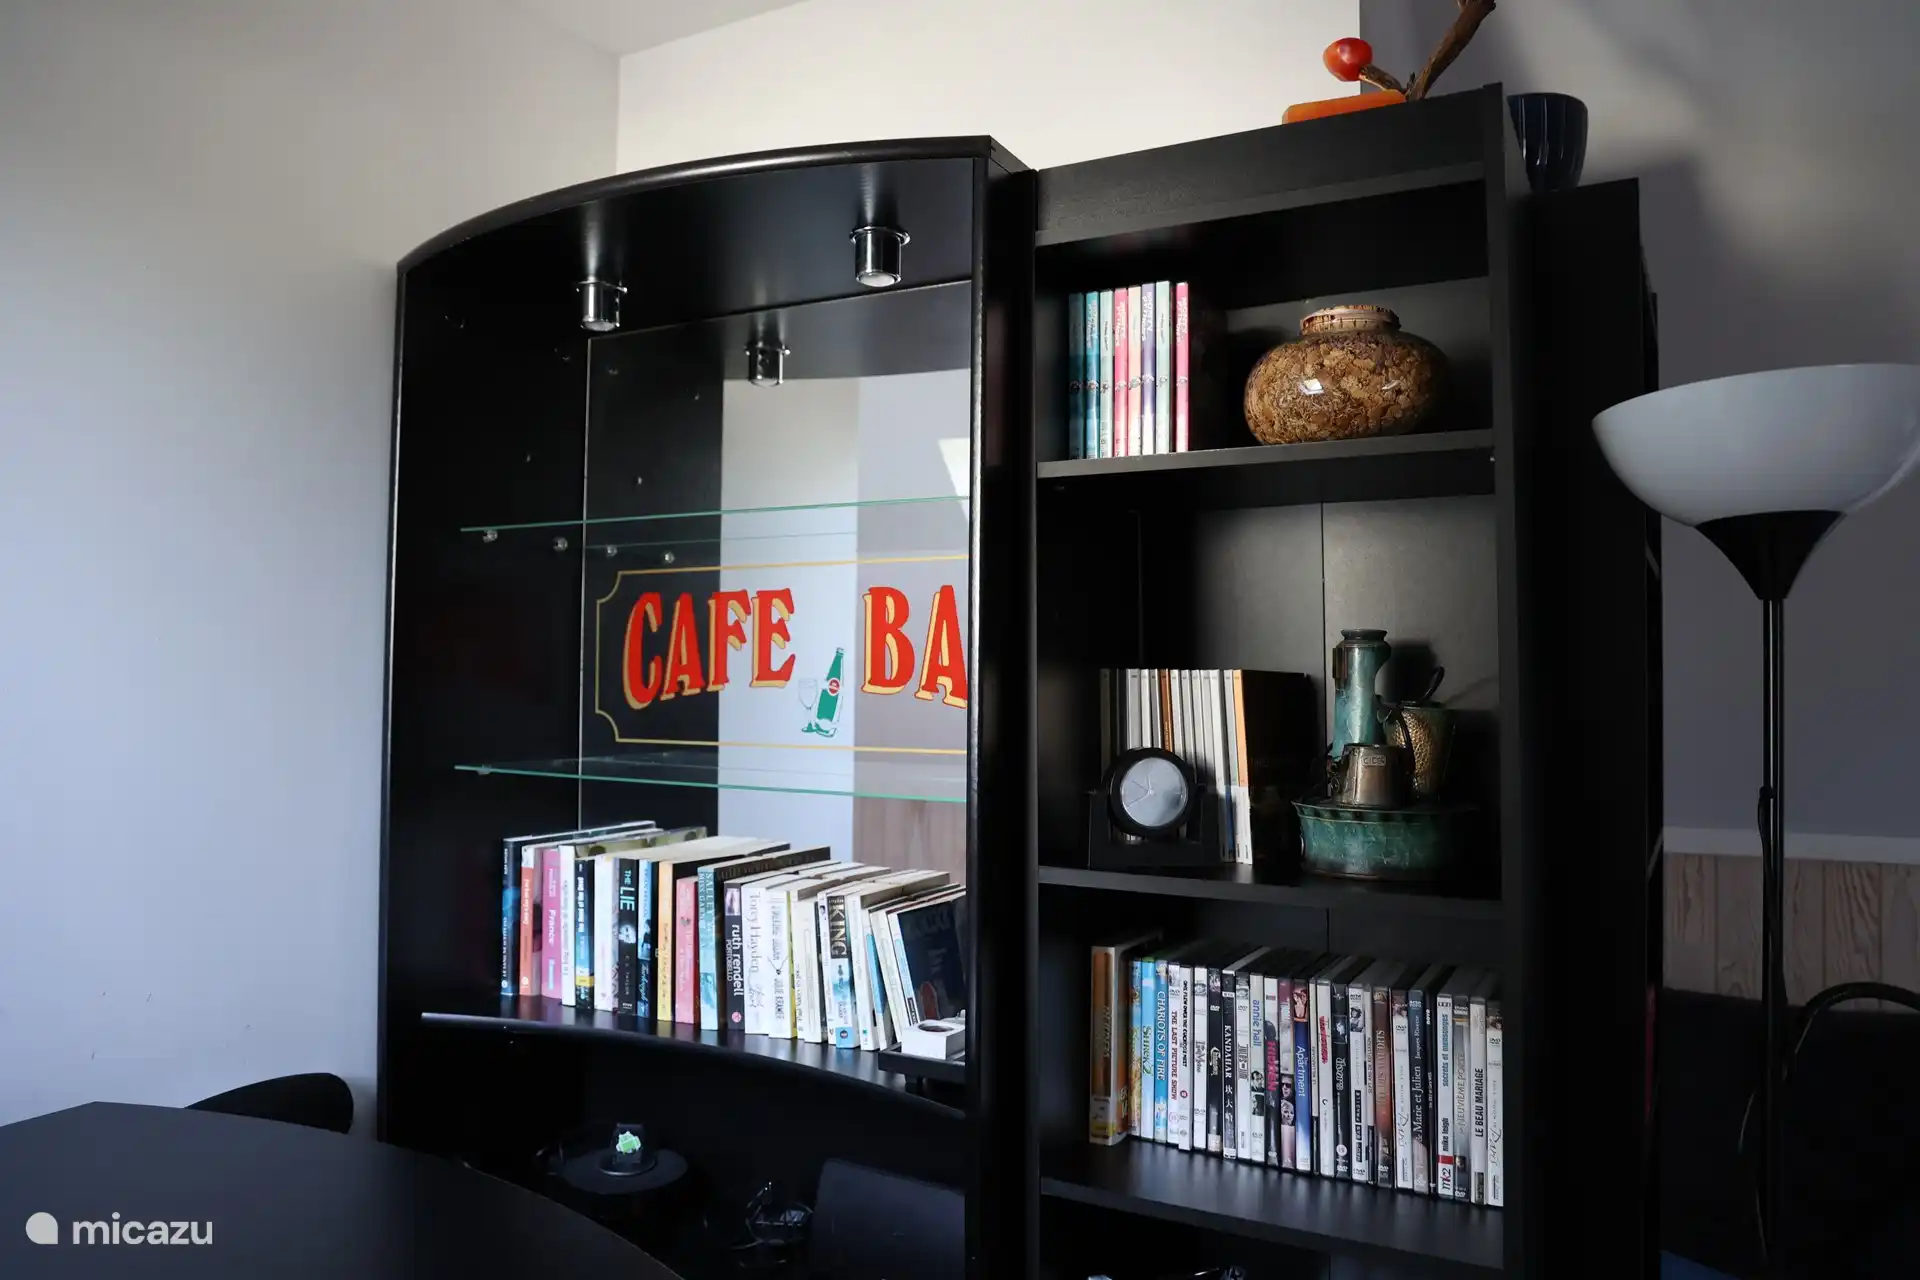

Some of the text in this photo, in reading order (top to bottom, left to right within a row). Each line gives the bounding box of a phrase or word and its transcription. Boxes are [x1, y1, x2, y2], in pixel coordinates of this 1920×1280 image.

[622, 584, 969, 711] CAFE BA
[619, 869, 636, 912] THE LIE
[746, 891, 762, 974] Torey Hayden
[829, 903, 847, 956] KING
[731, 924, 744, 997] ruth rendell
[775, 995, 785, 1020] KRAMER
[1252, 999, 1263, 1048] annie hall
[1156, 991, 1166, 1081] CHARIOTS OF FIRE
[1224, 1024, 1232, 1079] KANDAHAR
[1442, 1013, 1450, 1052] mensonges
[1144, 1062, 1153, 1077] 2
[1266, 1040, 1279, 1092] HIDDEN
[1296, 1045, 1305, 1097] Apartment
[1411, 1066, 1422, 1088] Julien
[1442, 1053, 1449, 1062] et
[1413, 1104, 1422, 1133] Marie
[1442, 1117, 1450, 1135] leigh
[1474, 1068, 1484, 1138] LE BEAU MARIAGE
[1440, 1167, 1452, 1190] mk2
